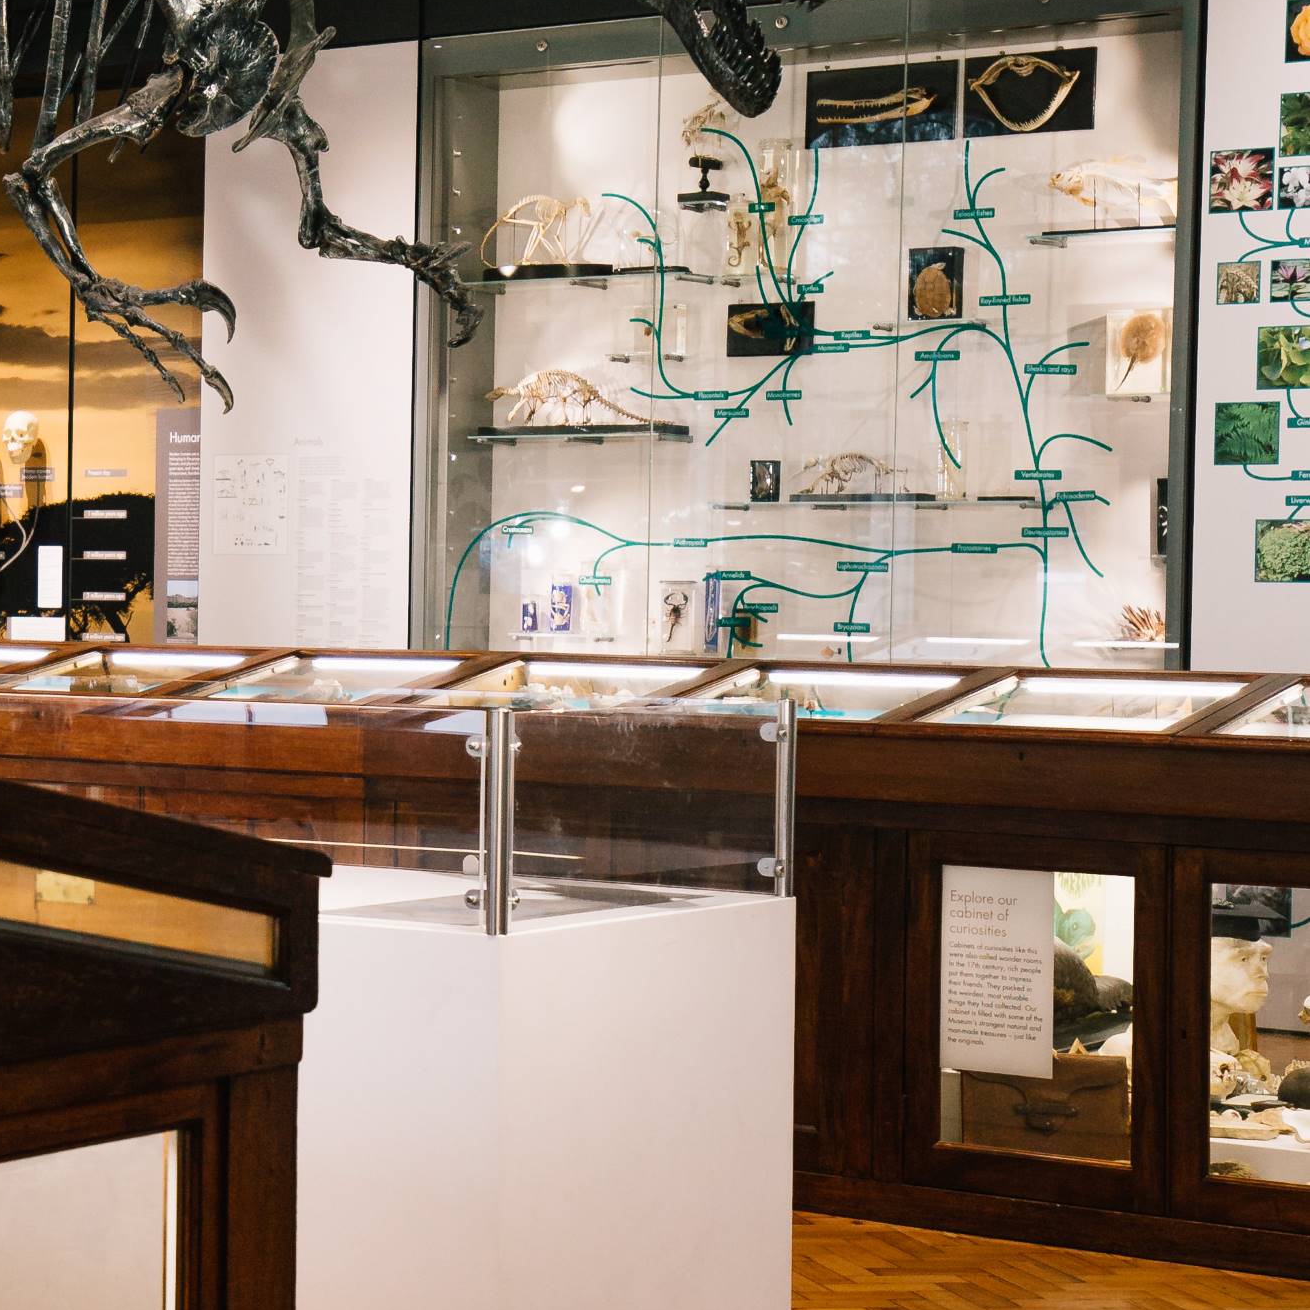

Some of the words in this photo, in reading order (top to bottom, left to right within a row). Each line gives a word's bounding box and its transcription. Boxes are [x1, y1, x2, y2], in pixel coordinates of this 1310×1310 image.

[950, 889, 994, 908] Explore
[997, 896, 1018, 906] our
[949, 907, 994, 920] cabinet
[996, 908, 1010, 921] of
[949, 924, 1008, 938] curiosities
[949, 940, 975, 950] Cabinets
[984, 944, 1013, 953] curiosities
[1015, 946, 1026, 954] like
[1027, 947, 1038, 955] this
[978, 953, 998, 961] called
[999, 955, 1022, 963] wonder
[967, 961, 981, 969] 17th
[1020, 967, 1041, 975] people
[975, 973, 999, 982] together
[986, 982, 1000, 991] They
[1002, 984, 1025, 993] packed
[948, 998, 966, 1007] things
[967, 1000, 980, 1008] they
[1024, 1004, 1037, 1012] Our
[1002, 994, 1029, 1002] valuable
[977, 1010, 993, 1018] filled
[993, 1011, 1007, 1019] with
[1025, 1013, 1033, 1021] of
[1033, 1014, 1043, 1023] the
[978, 1020, 1006, 1029] strangest
[1006, 1022, 1028, 1030] natural
[1029, 1024, 1042, 1032] and
[947, 1027, 979, 1035] man-made
[980, 1029, 1007, 1038] treasures
[1013, 1033, 1024, 1041] just
[1025, 1032, 1036, 1041] like
